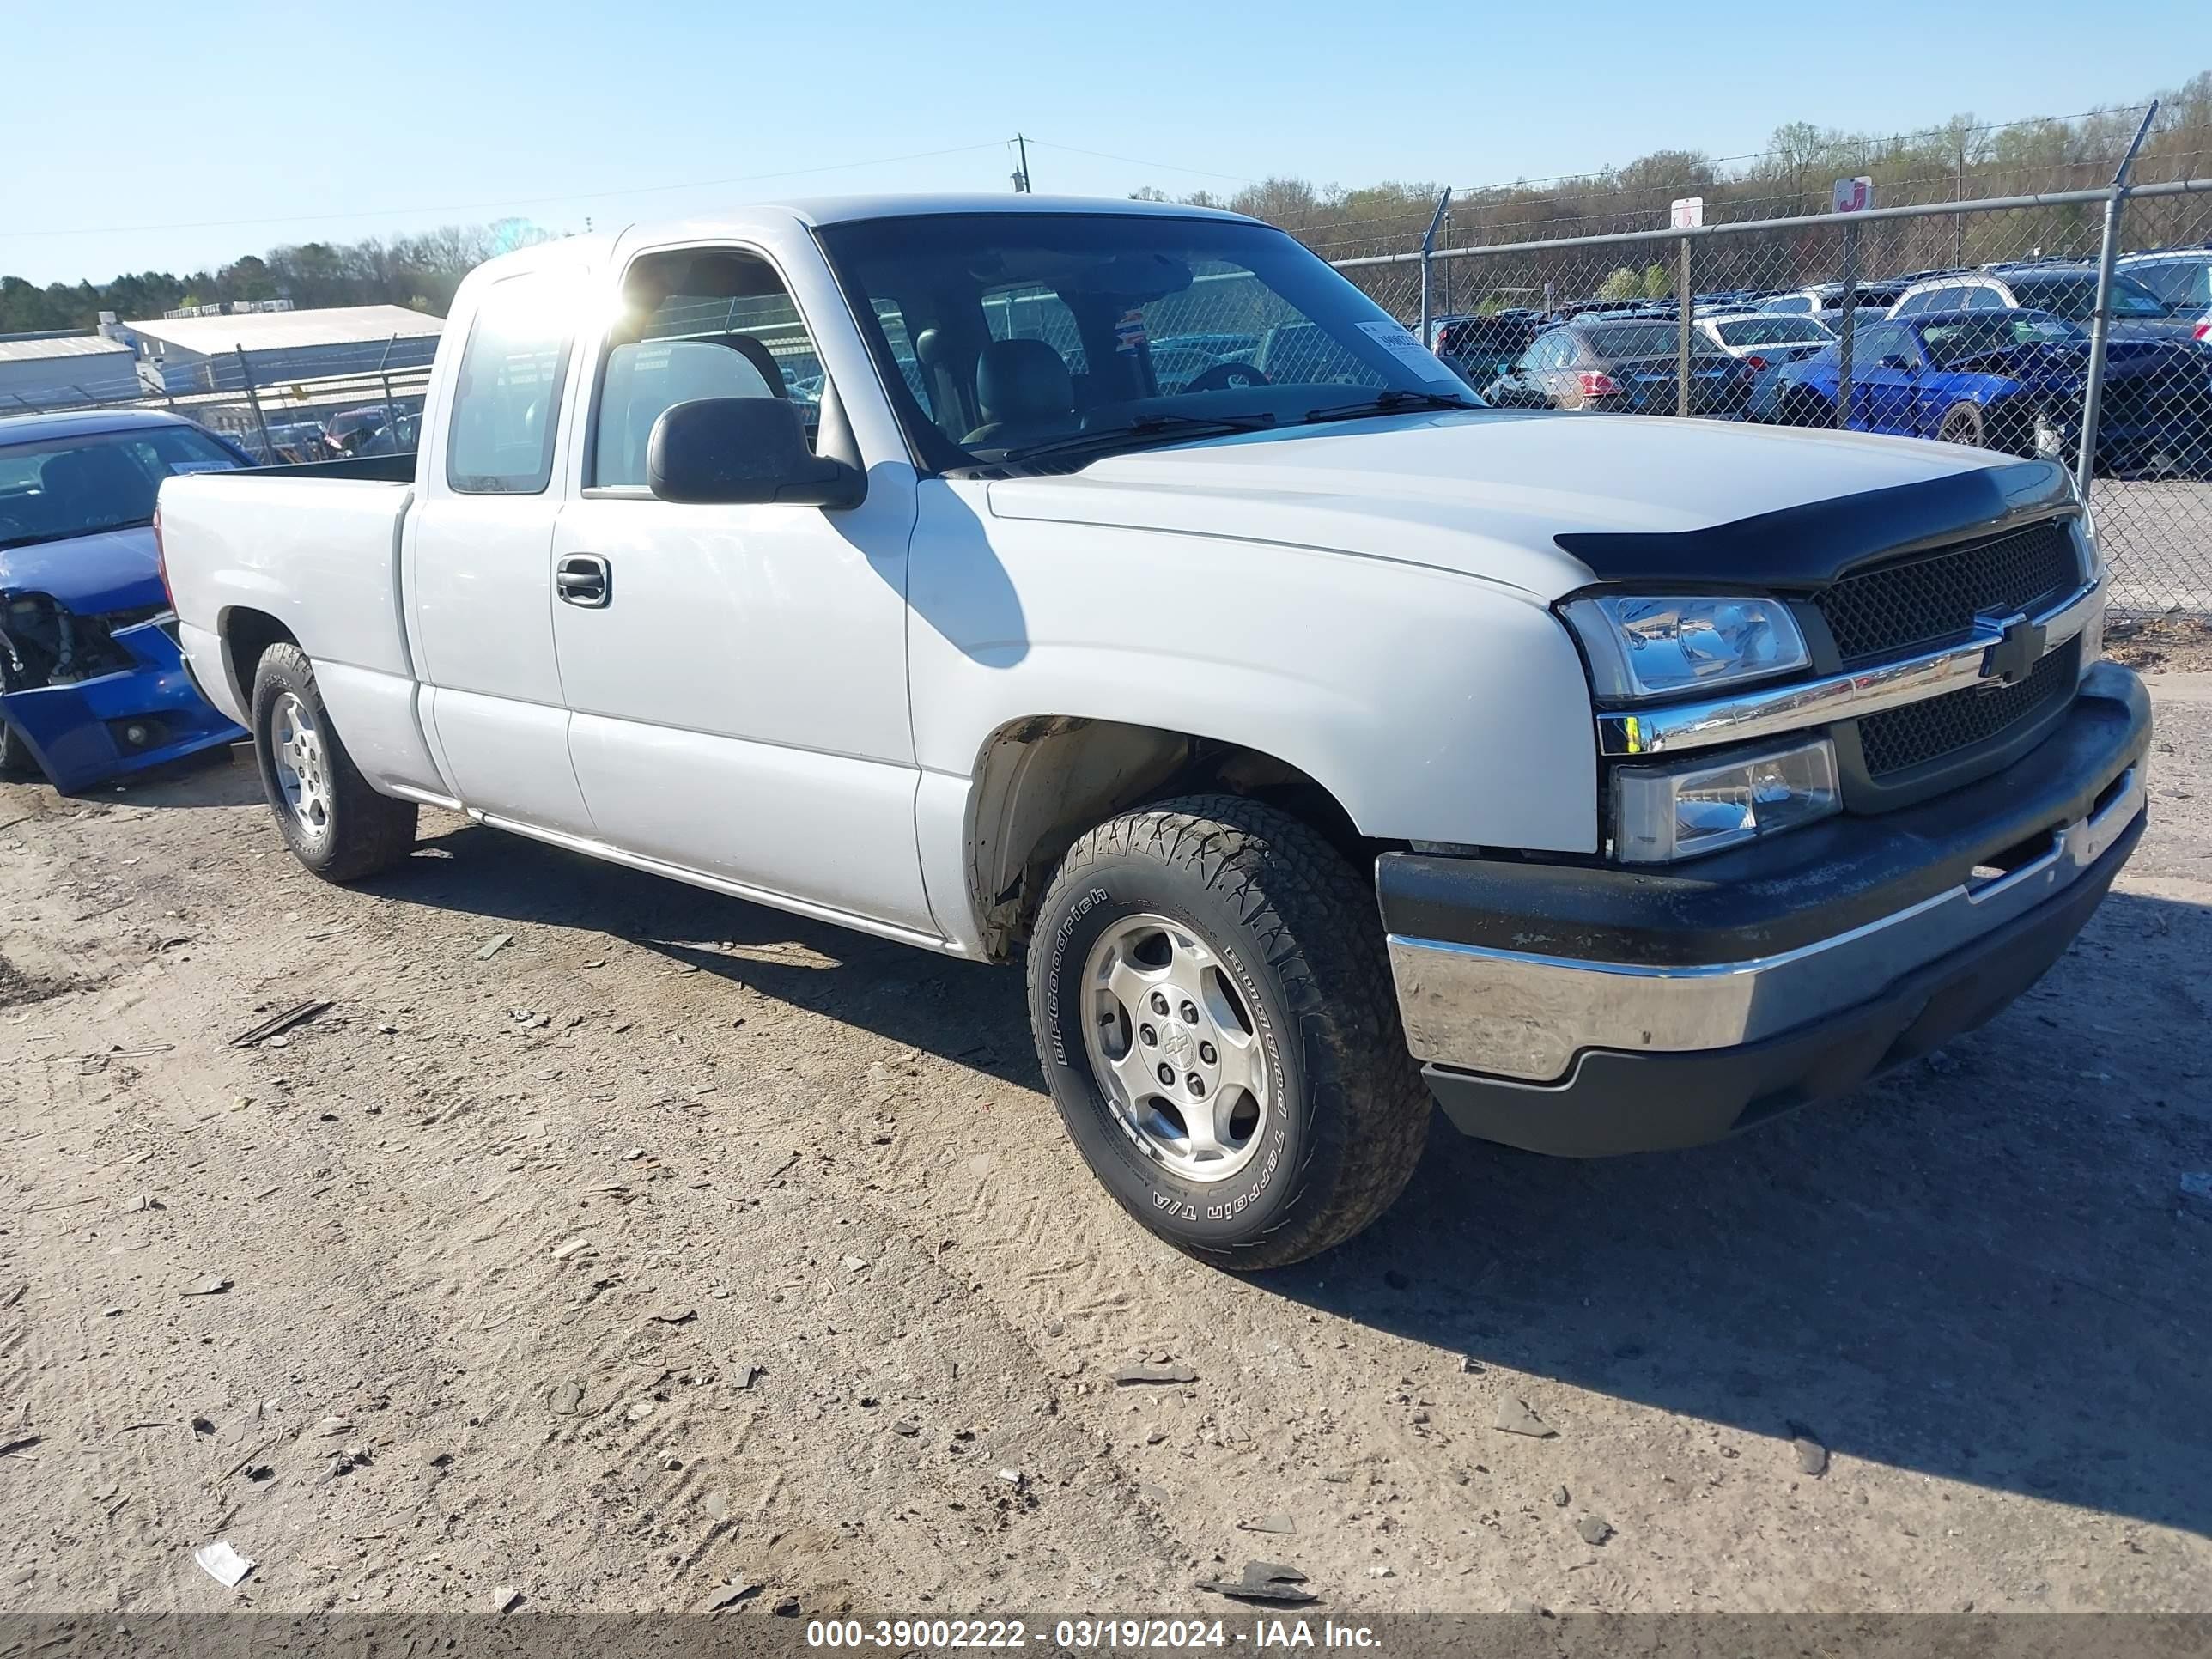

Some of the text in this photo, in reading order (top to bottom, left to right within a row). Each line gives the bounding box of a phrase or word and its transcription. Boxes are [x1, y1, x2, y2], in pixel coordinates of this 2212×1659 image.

[1840, 182, 1866, 212] J
[1047, 887, 1108, 1066] BFGoodrich
[1224, 946, 1288, 1120] Rugged
[1152, 1190, 1199, 1221] T/A
[1206, 1130, 1285, 1220] Terrain
